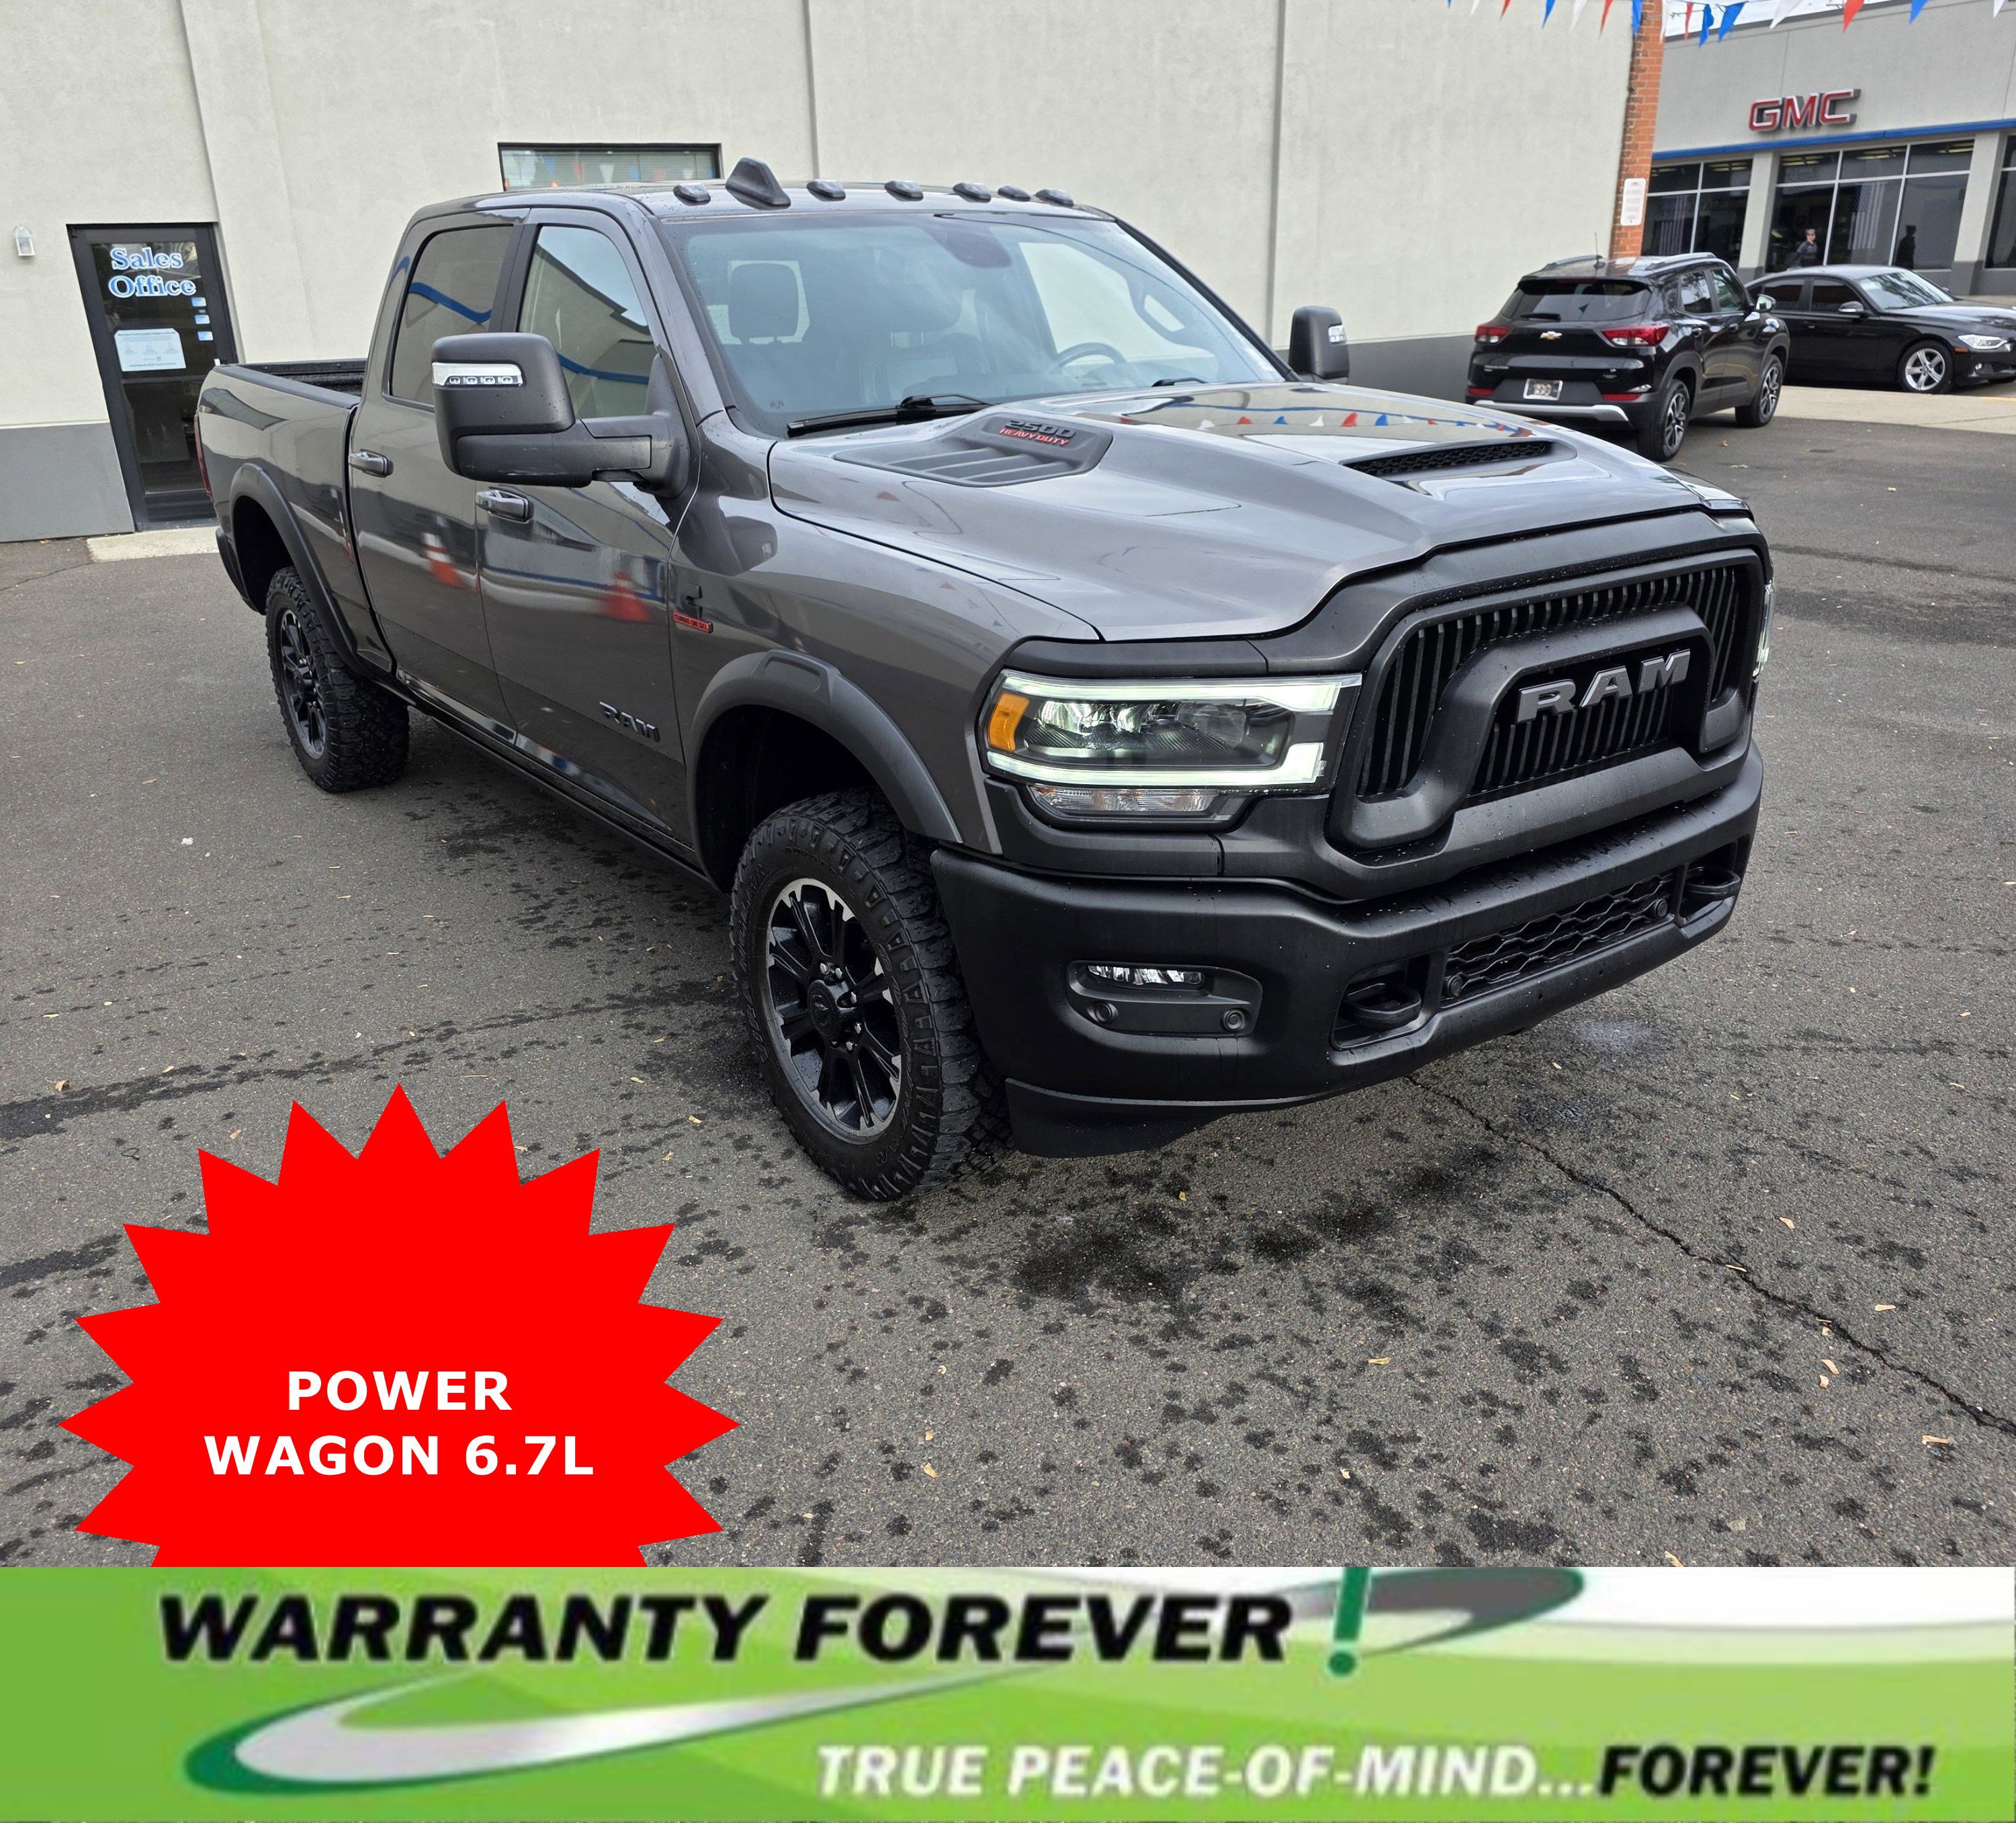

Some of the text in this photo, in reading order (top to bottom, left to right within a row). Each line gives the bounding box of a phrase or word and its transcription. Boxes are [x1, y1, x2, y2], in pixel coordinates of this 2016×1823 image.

[1749, 89, 1861, 132] GMC
[109, 247, 184, 270] Sales
[108, 274, 197, 298] Office
[999, 427, 1069, 446] HEAVY DUTY
[1005, 419, 1076, 439] 2500
[674, 613, 708, 630] TURBO DIESEL
[1515, 648, 1691, 725] RAM
[599, 701, 661, 743] RAM
